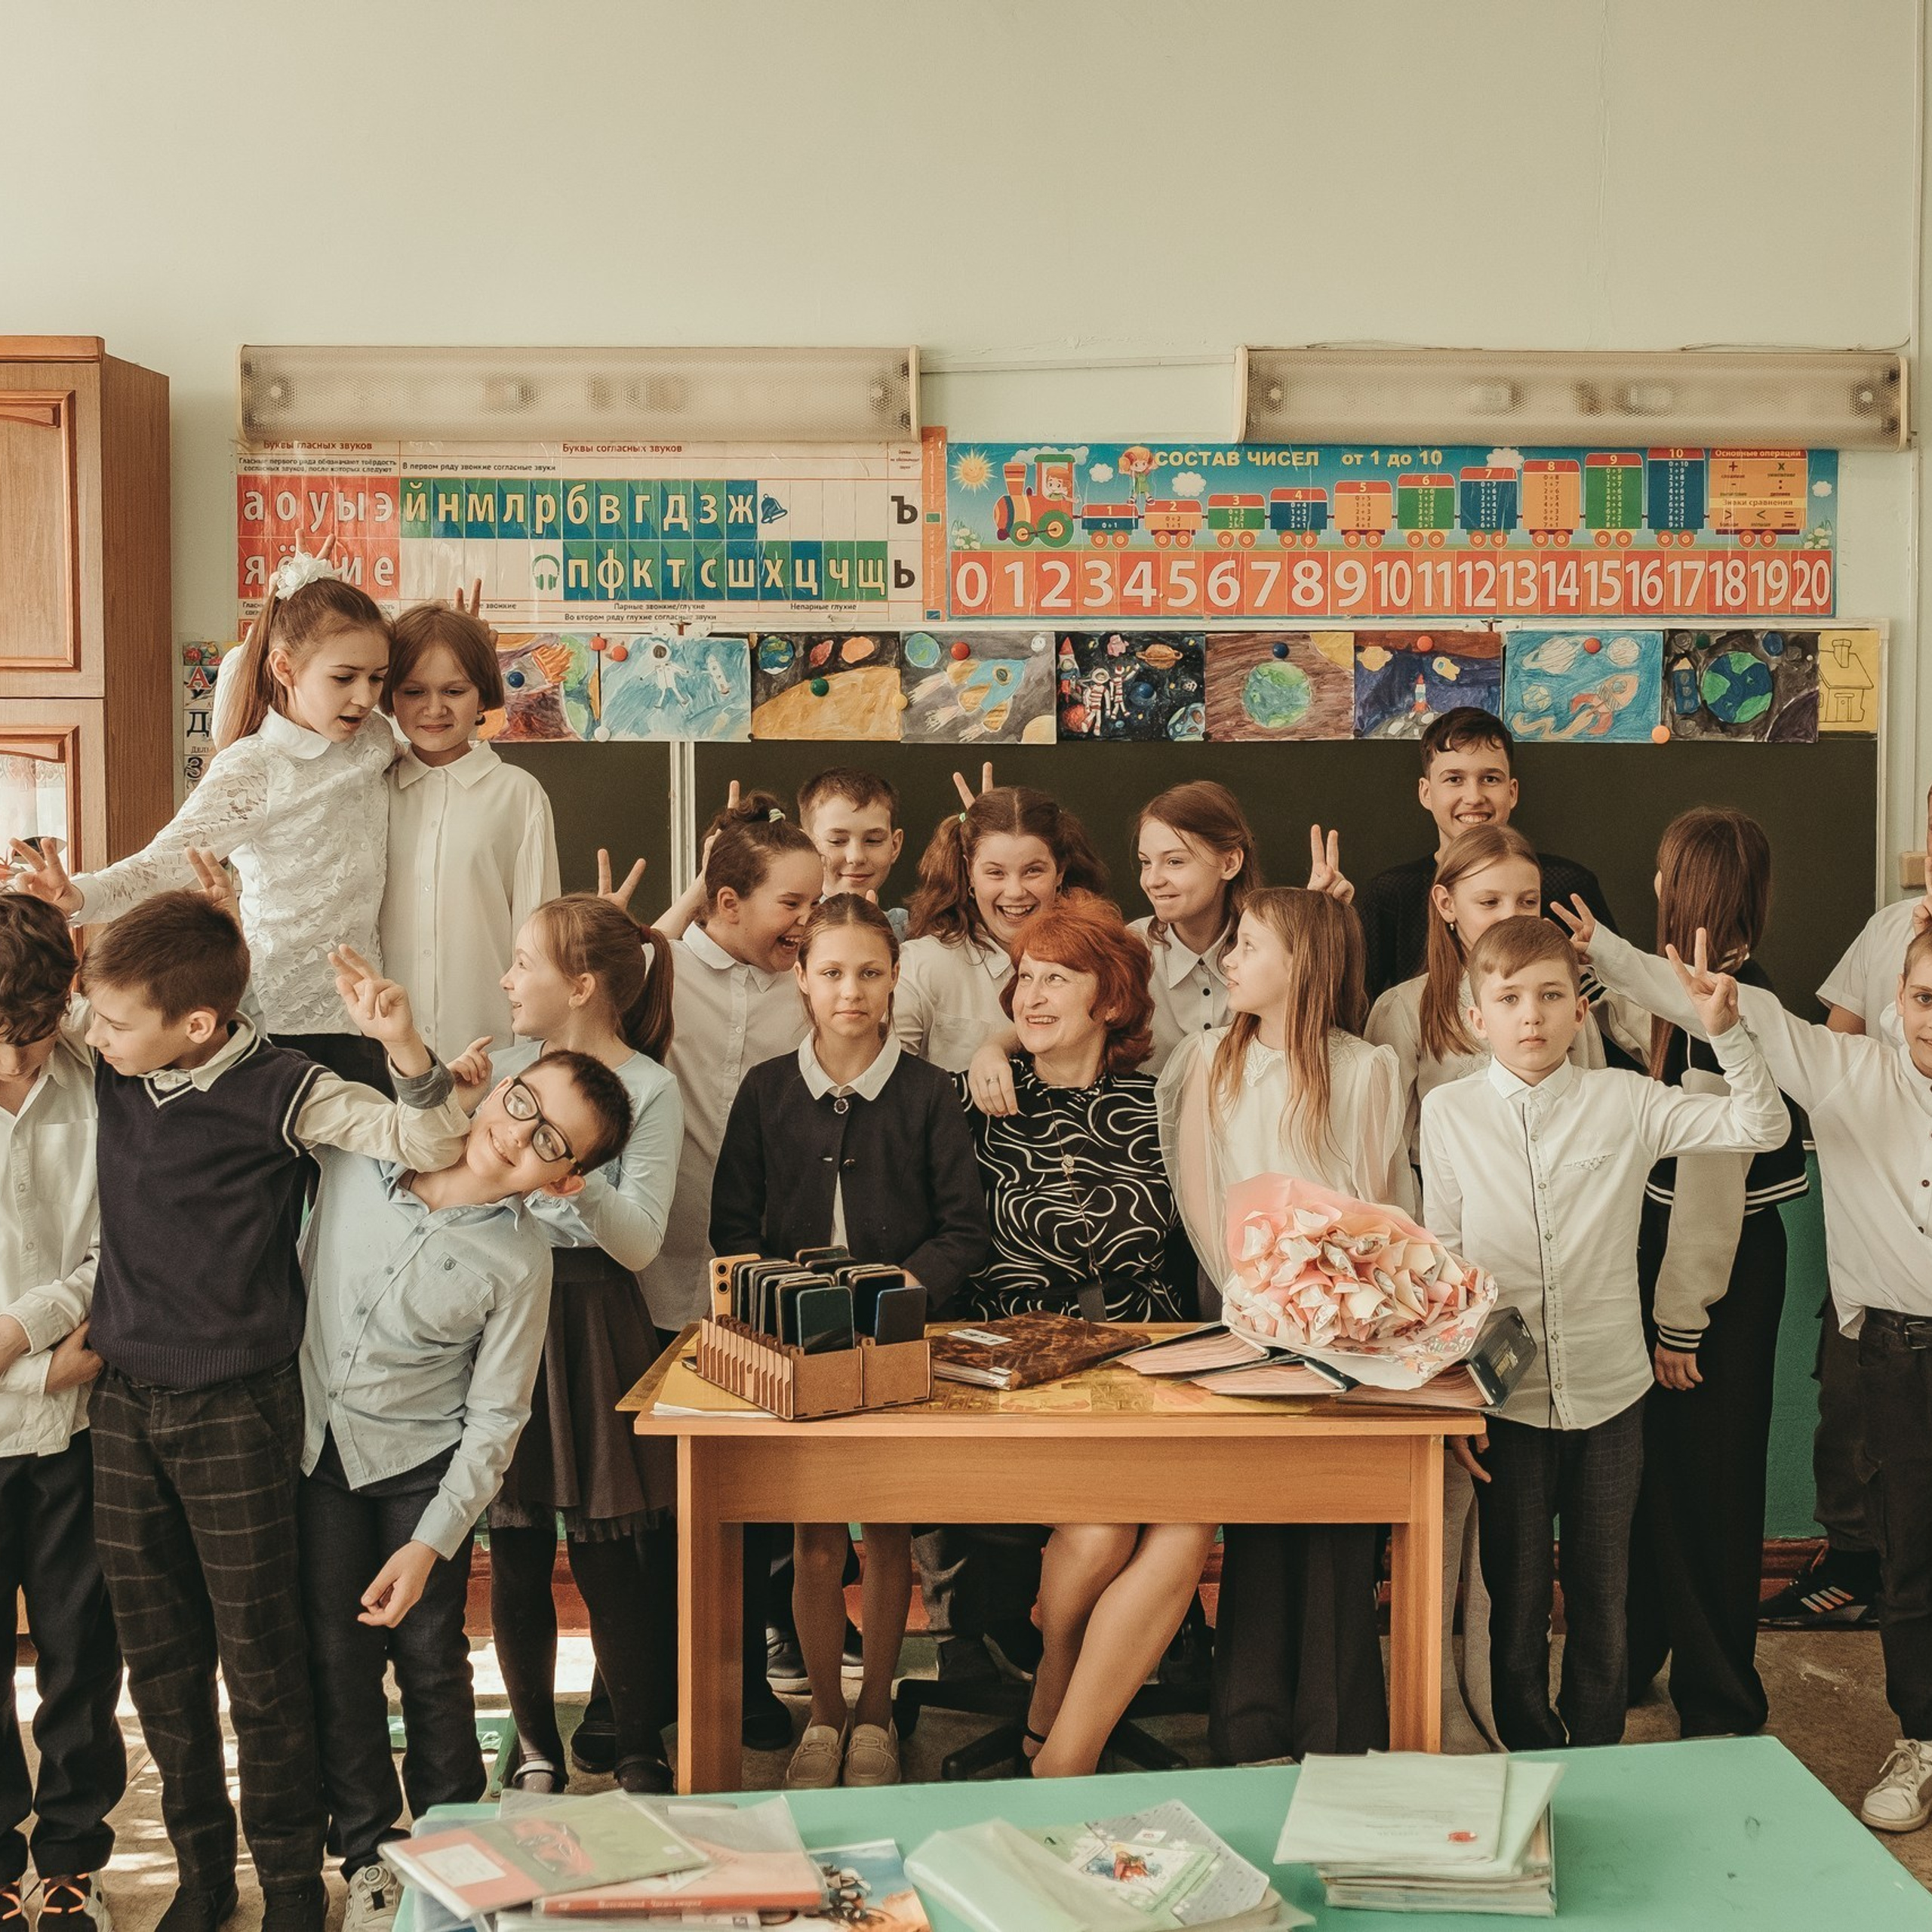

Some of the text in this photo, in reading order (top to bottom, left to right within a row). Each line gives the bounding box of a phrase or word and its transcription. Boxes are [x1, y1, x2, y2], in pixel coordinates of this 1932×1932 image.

[340, 442, 373, 451] звуков
[563, 444, 682, 454] Буквы согласных звуков
[1669, 448, 1684, 458] 10
[1155, 451, 1442, 467] СОСТАВ ЧИСЕЛ от 1 до 10
[1610, 454, 1617, 465] 9
[1547, 461, 1555, 471] 8
[1485, 469, 1493, 478] 7
[1422, 475, 1429, 485] 6
[1360, 482, 1366, 492] 5
[1232, 495, 1240, 506] 3
[1295, 491, 1303, 500] 4
[405, 481, 754, 534] й н м л р б в г д з ж
[1107, 506, 1112, 515] 1
[1170, 501, 1177, 511] 2
[243, 491, 393, 533] а о у ы э
[243, 555, 264, 585] я
[342, 557, 362, 586] и
[374, 556, 394, 586] е
[568, 549, 886, 599] п ф к т с ш х ц ч щ
[956, 561, 988, 608] 0
[1004, 561, 1025, 608] 1
[1041, 561, 1072, 608] 2
[1083, 561, 1113, 608] 3
[1123, 561, 1157, 608] 4
[1168, 561, 1198, 608] 5
[1208, 561, 1241, 608] 6
[1250, 561, 1281, 608] 7
[1291, 561, 1324, 608] 8
[1334, 561, 1367, 608] 9
[1373, 560, 1412, 608] 10
[1417, 560, 1451, 608] 11
[1458, 560, 1497, 608] 12
[1500, 560, 1538, 608] 13
[1541, 560, 1580, 608] 14
[1583, 560, 1622, 608] 15
[1626, 560, 1663, 608] 16
[1667, 560, 1706, 608] 17
[1709, 560, 1748, 608] 18
[1750, 560, 1789, 608] 19
[1792, 560, 1831, 608] 20
[614, 603, 644, 611] Парные
[790, 603, 829, 611] Непарные
[186, 666, 211, 688] А
[186, 712, 209, 737] Д
